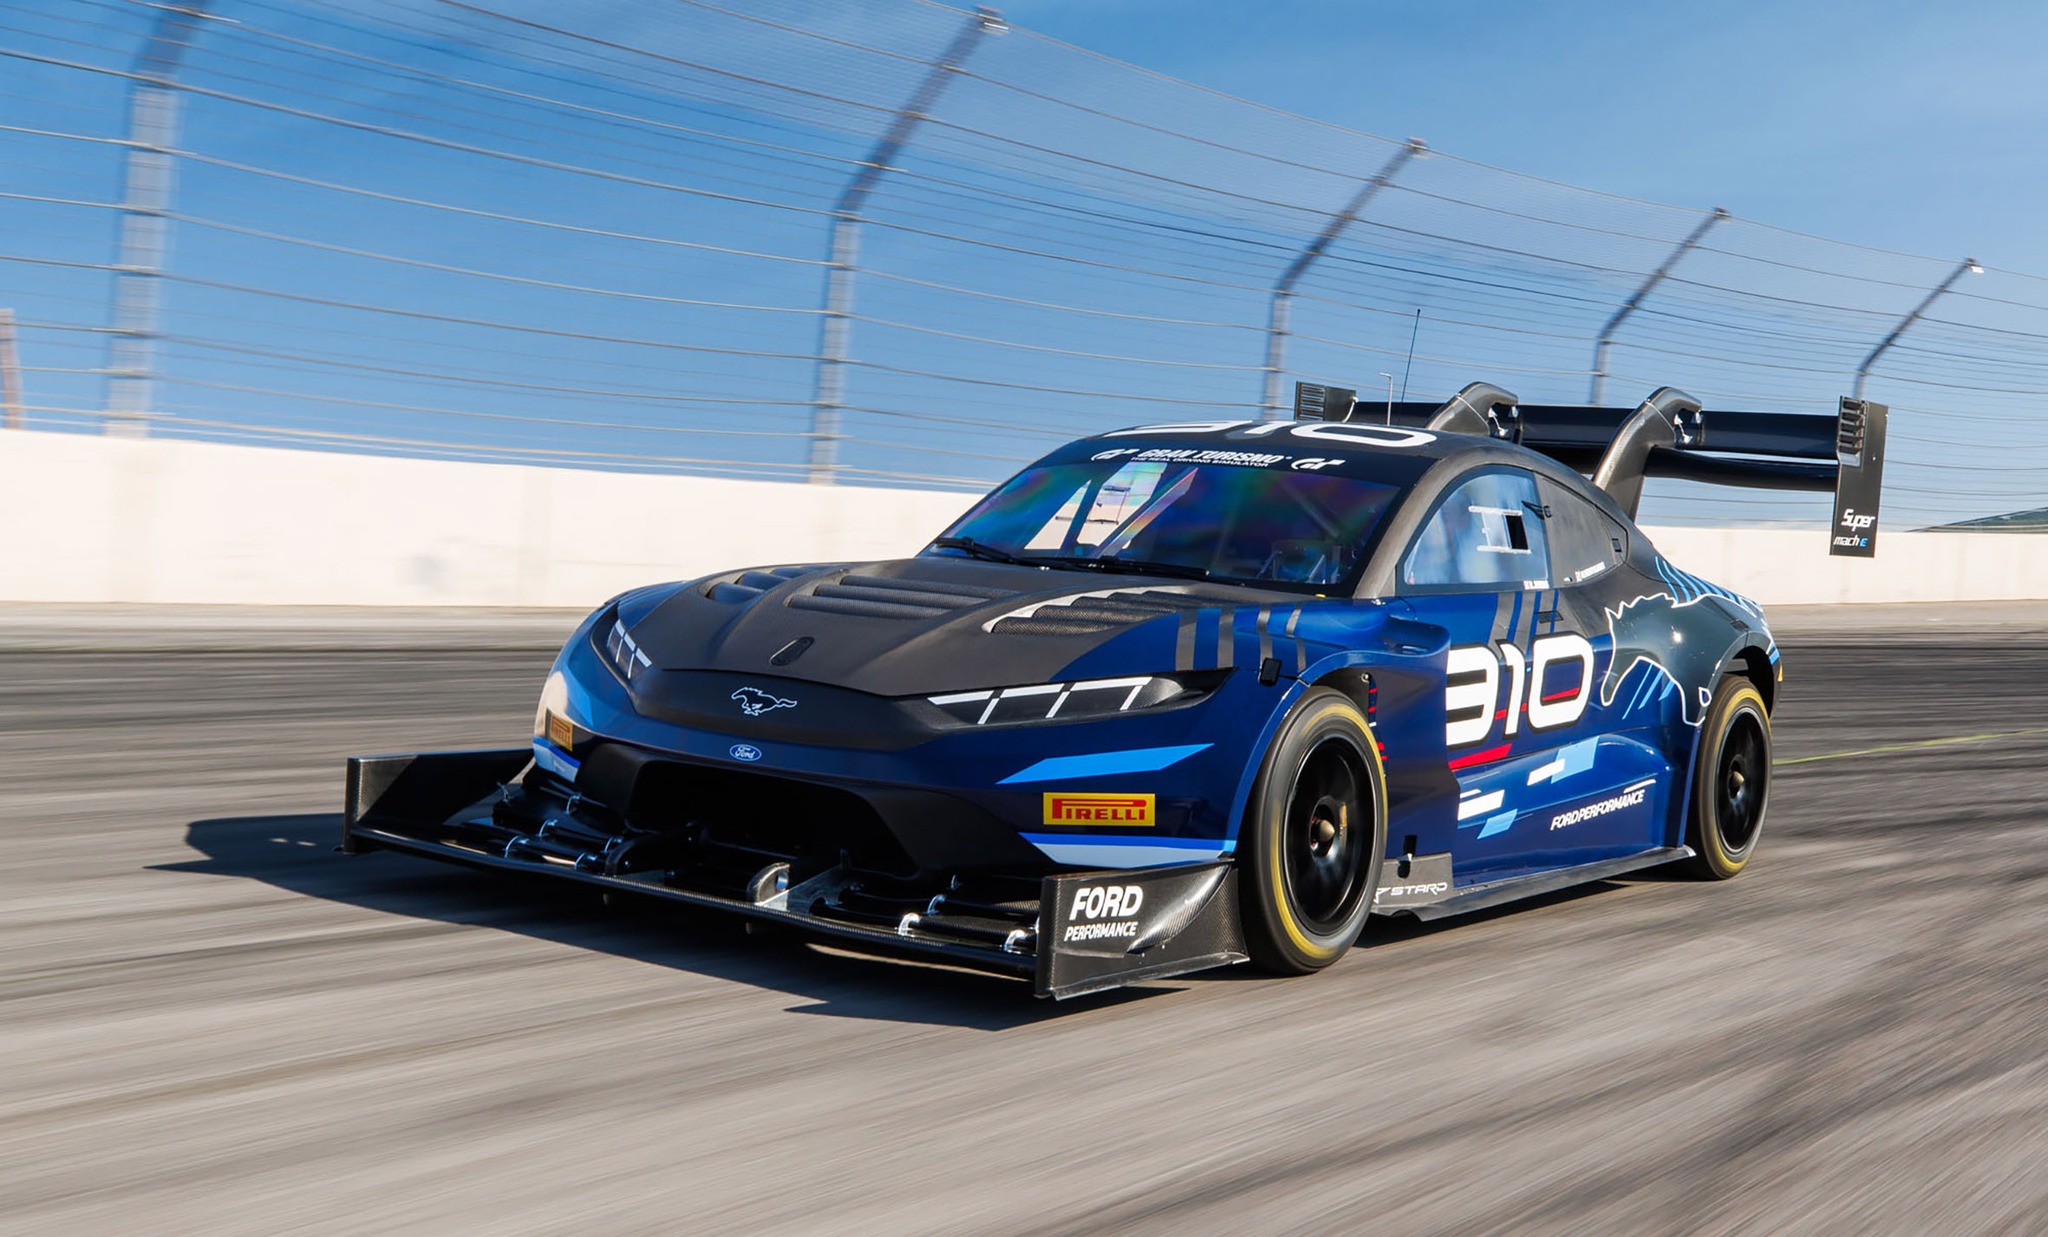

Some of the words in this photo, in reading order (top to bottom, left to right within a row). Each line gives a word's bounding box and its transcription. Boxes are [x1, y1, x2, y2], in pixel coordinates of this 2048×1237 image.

[1137, 449, 1199, 458] GRAN
[1192, 450, 1285, 464] TURISMO
[1211, 458, 1269, 468] SIMULATOR
[1840, 508, 1876, 532] Super
[1445, 632, 1595, 748] 310
[734, 746, 757, 759] Ford
[1052, 798, 1147, 821] PIRELLI
[1549, 808, 1580, 832] FORD
[1576, 788, 1646, 823] PERFORMANCE
[1389, 881, 1448, 897] STARD
[1069, 885, 1144, 921] FORD
[1063, 921, 1139, 942] PERFORMANCE
